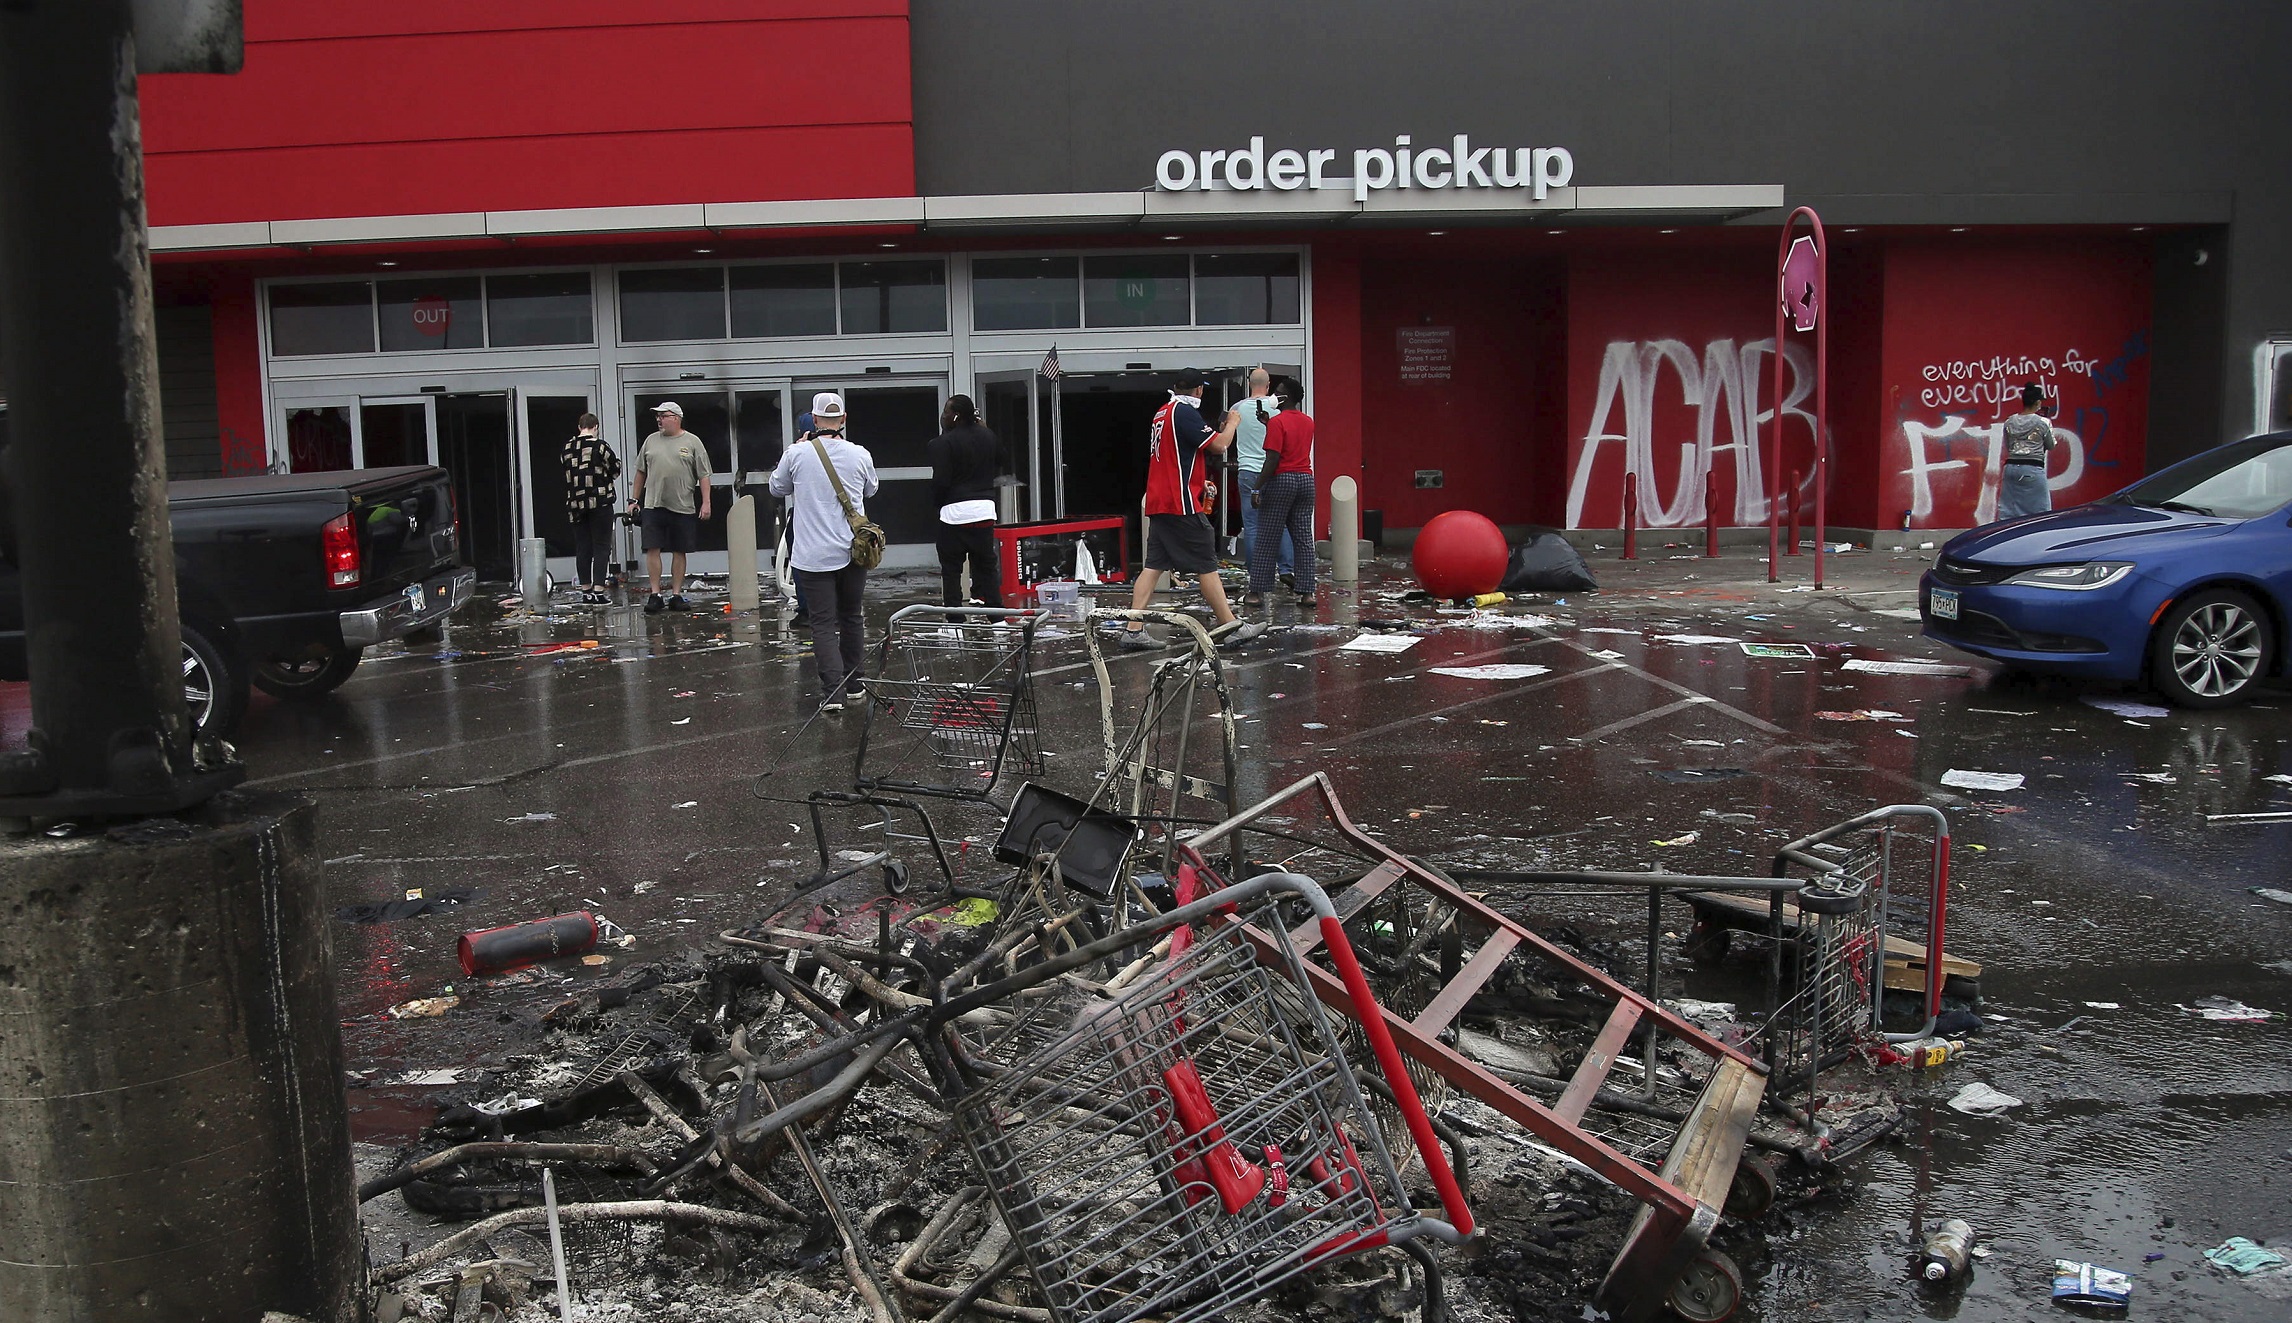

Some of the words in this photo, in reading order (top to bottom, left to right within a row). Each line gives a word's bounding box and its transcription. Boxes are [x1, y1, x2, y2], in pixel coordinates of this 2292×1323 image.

[1155, 135, 1335, 191] order
[1353, 134, 1574, 201] pickup
[1127, 283, 1144, 297] IN
[413, 308, 449, 323] OUT
[1922, 356, 2057, 382] everything
[2061, 349, 2099, 377] for
[1566, 337, 1834, 530] ACAB
